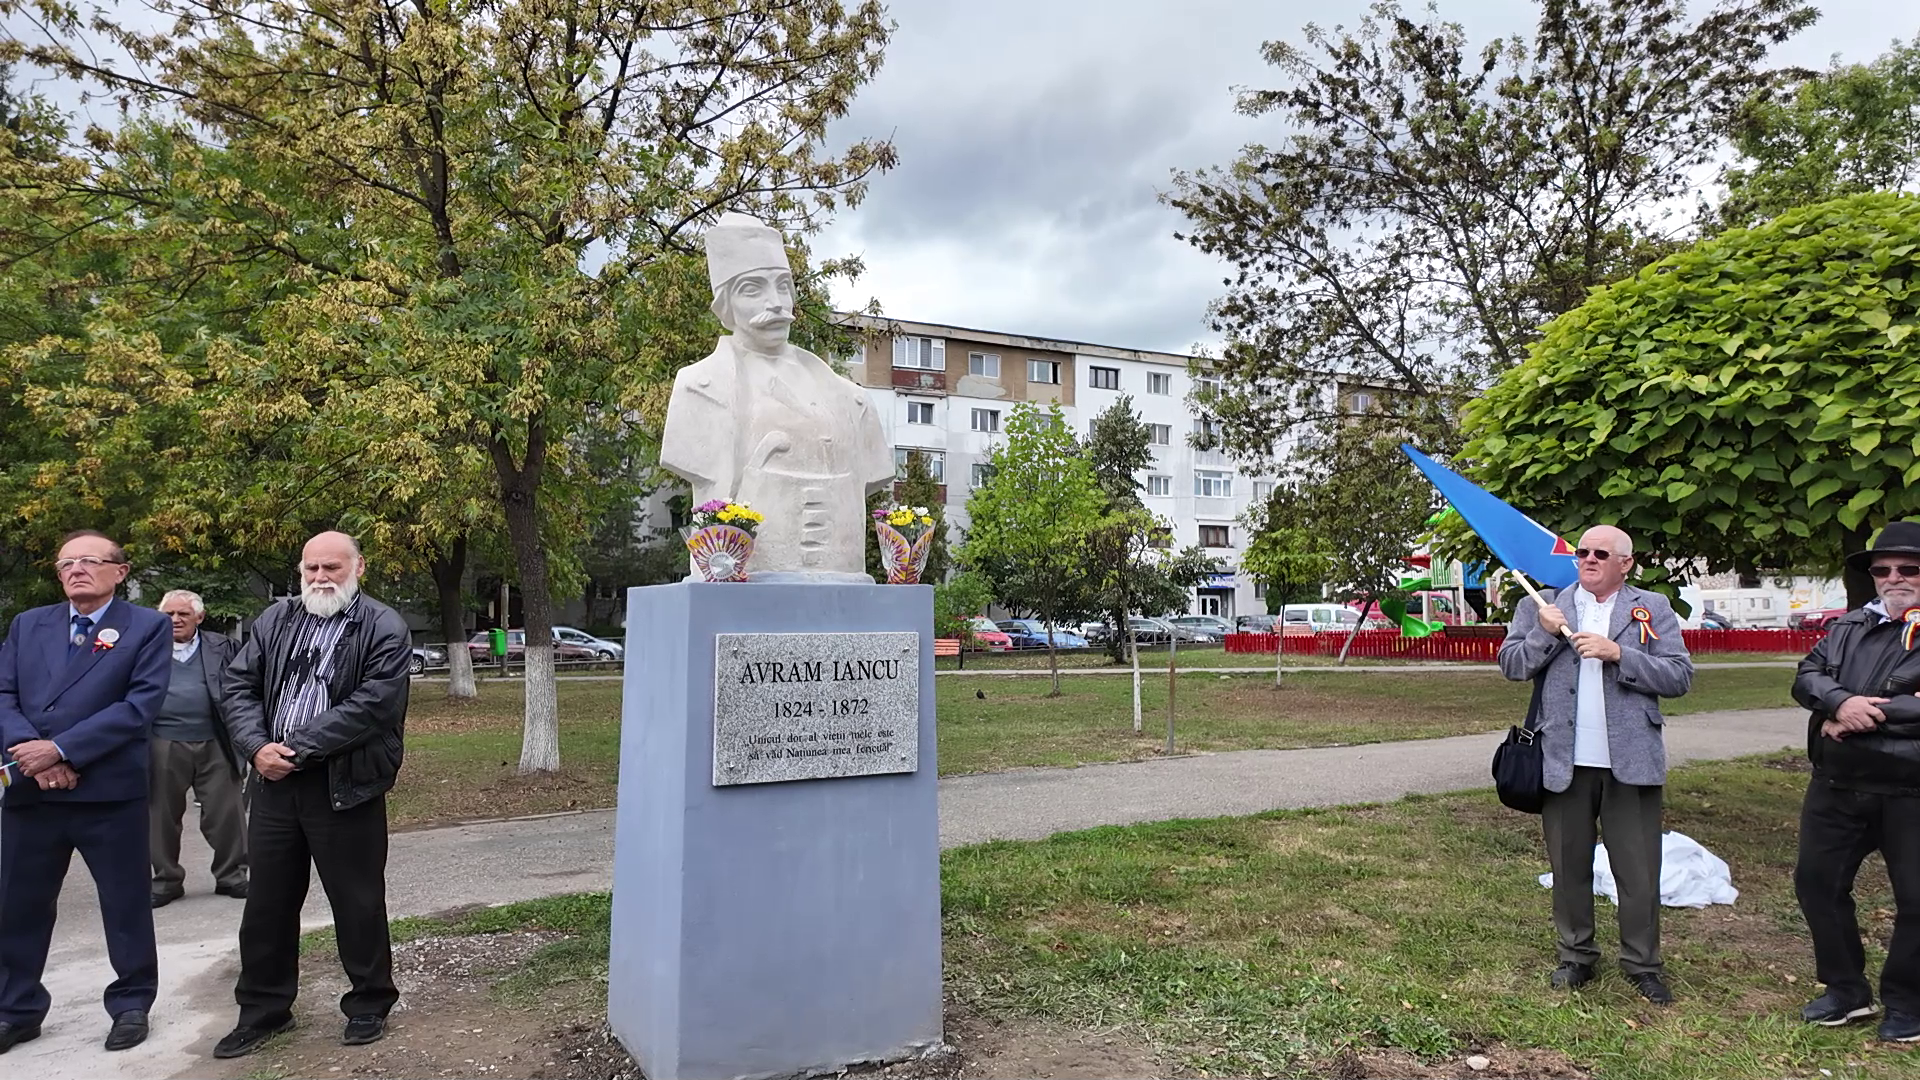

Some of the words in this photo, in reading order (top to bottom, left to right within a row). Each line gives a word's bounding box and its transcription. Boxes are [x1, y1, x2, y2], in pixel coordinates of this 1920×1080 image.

[740, 661, 822, 683] AVRAM
[833, 659, 899, 681] IANCU
[775, 701, 812, 718] 1824
[832, 699, 868, 715] 1872
[787, 733, 802, 742] dor
[808, 732, 817, 742] al
[851, 729, 872, 739] mele
[878, 729, 894, 738] este
[833, 747, 851, 755] mea
